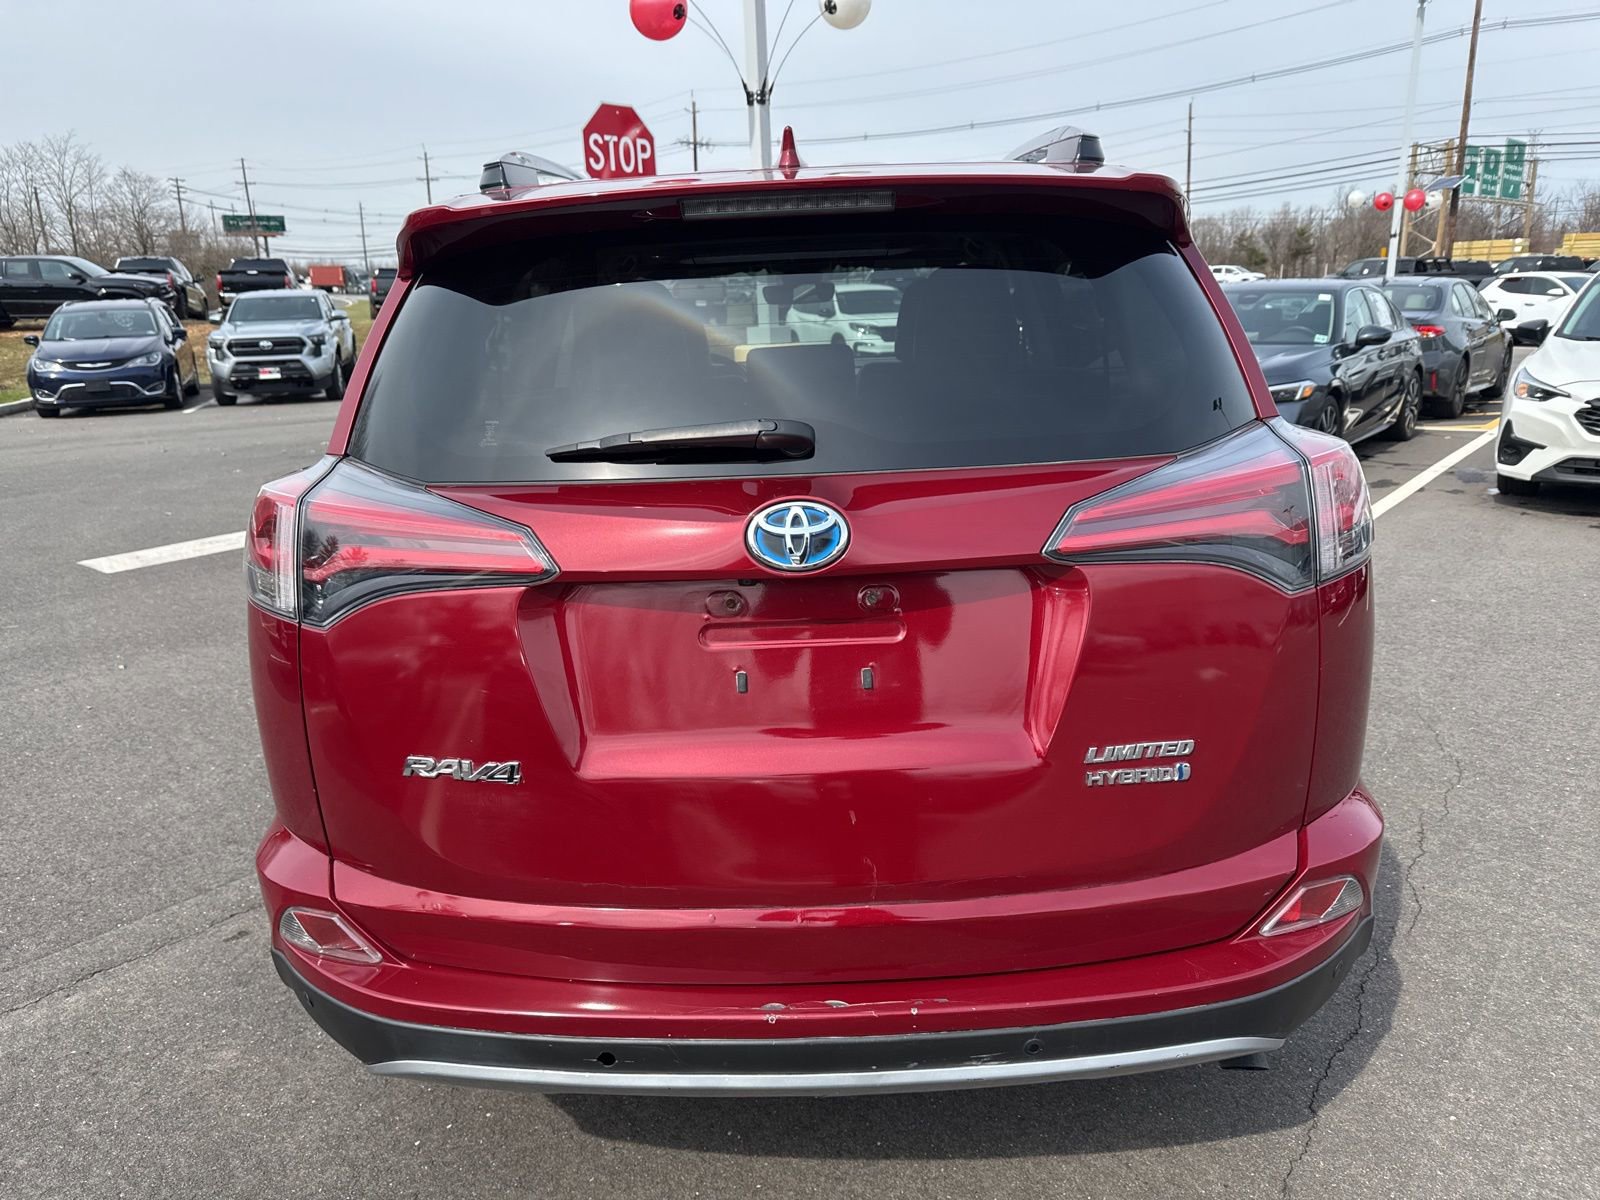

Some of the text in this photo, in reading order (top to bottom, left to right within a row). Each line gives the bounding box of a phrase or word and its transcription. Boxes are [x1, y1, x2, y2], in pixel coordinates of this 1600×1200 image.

[588, 132, 652, 174] STOP
[1083, 739, 1195, 764] LIMITED
[402, 756, 521, 784] RAV4
[1086, 766, 1175, 787] HYBRID
